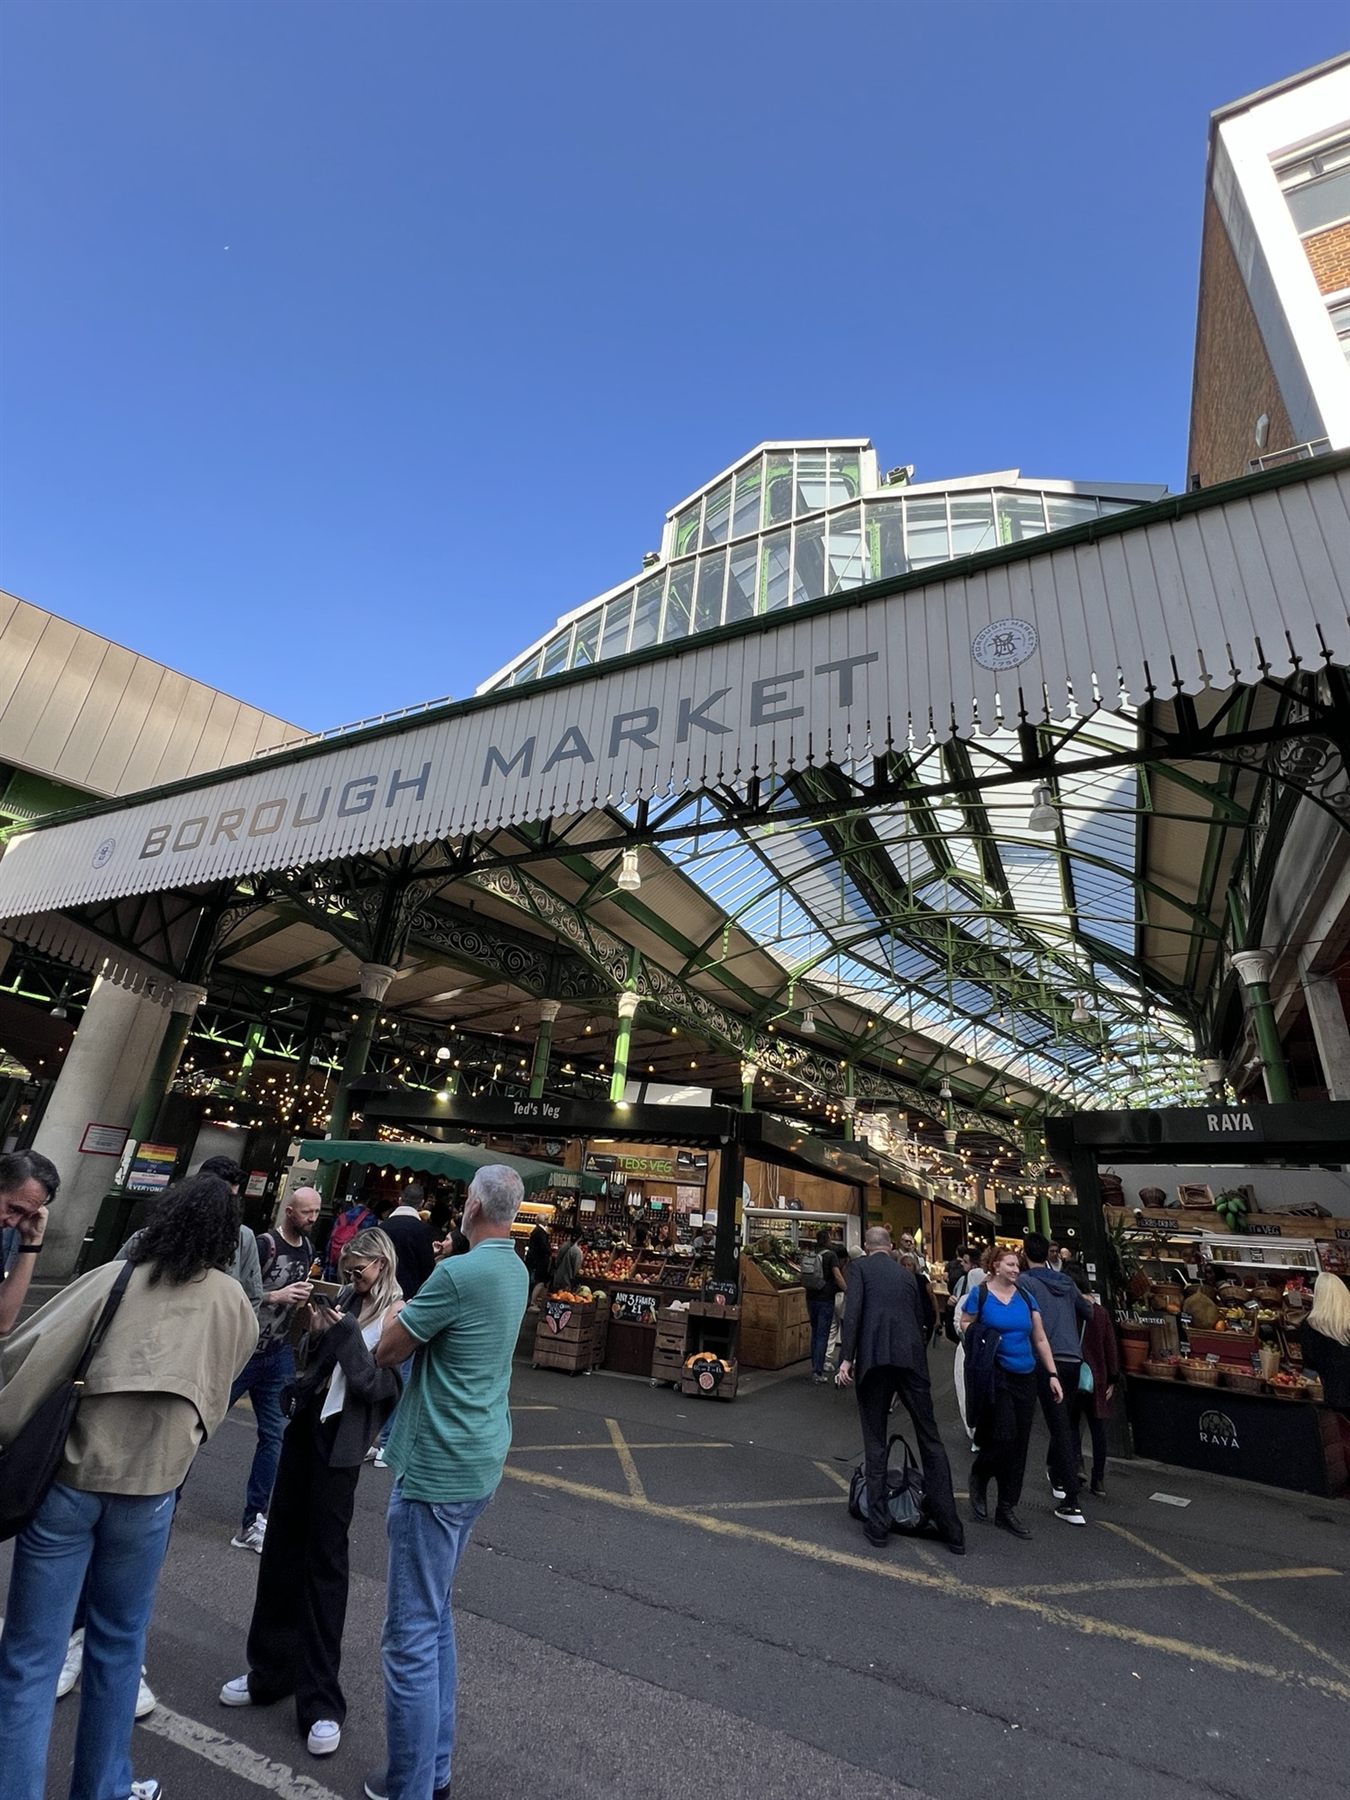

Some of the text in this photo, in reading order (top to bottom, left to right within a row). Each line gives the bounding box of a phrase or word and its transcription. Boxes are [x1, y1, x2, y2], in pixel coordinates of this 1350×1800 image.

[138, 651, 879, 861] BOROUGH MARKET
[513, 1101, 561, 1119] Ted's Veg
[1207, 1113, 1254, 1131] RAYA
[649, 1159, 672, 1173] VEG
[128, 1184, 164, 1193] EVERYONE
[1261, 1224, 1280, 1235] VEG
[616, 1292, 628, 1303] ANY
[627, 1293, 635, 1306] 3
[631, 1304, 642, 1314] £1
[1199, 1432, 1240, 1449] RAYA
